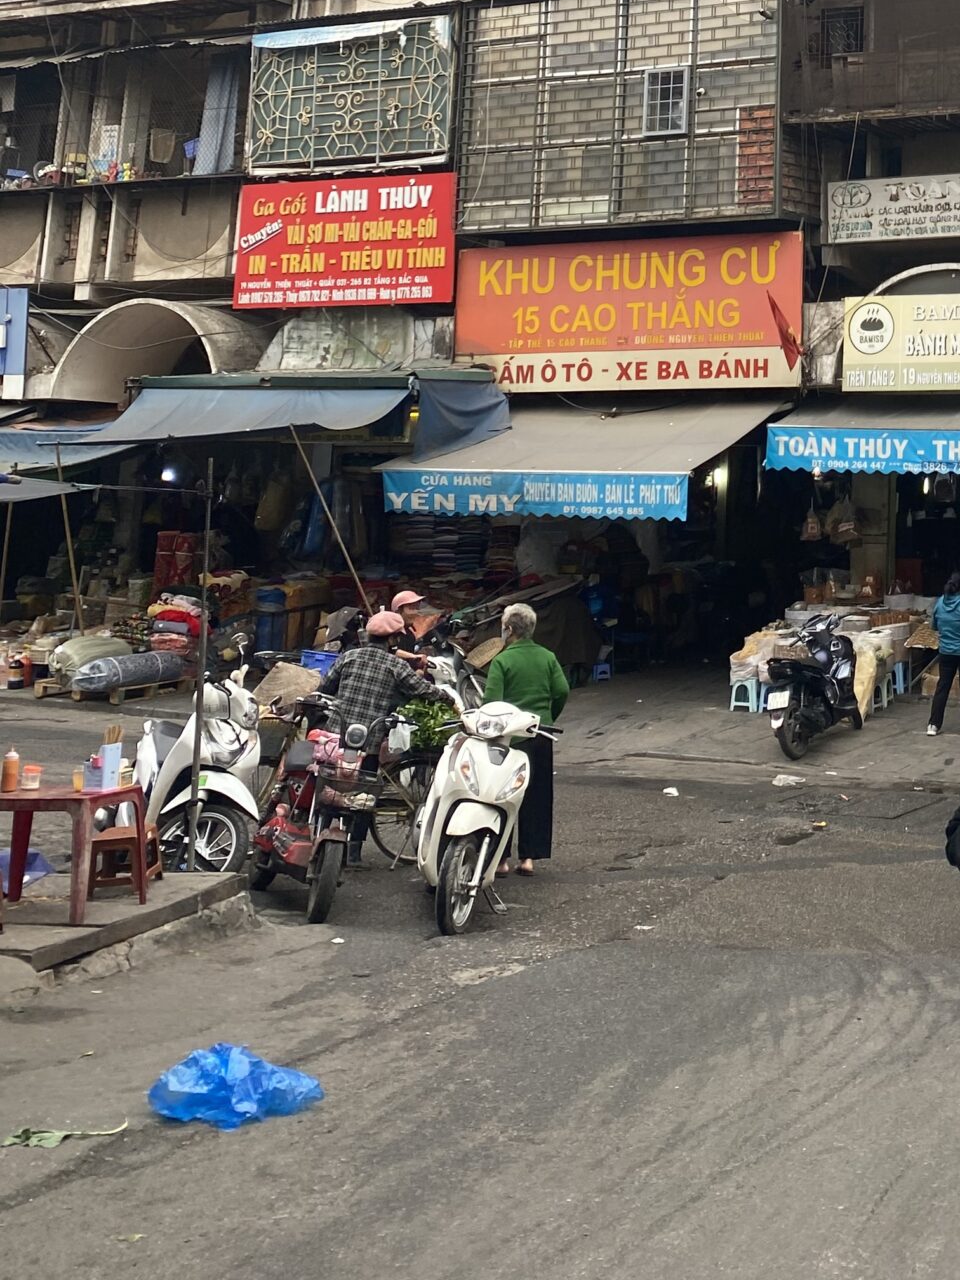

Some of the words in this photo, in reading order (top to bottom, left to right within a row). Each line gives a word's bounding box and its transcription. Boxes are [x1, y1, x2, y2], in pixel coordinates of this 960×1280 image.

[253, 198, 275, 216] Ga
[279, 192, 308, 215] Gối
[315, 184, 368, 213] LÀNH
[378, 178, 433, 210] THỦY
[240, 219, 283, 249] Chuyên:
[287, 218, 305, 245] VẢI
[248, 254, 267, 276] IN
[340, 245, 383, 271] THÊU
[386, 249, 403, 269] VI
[406, 241, 446, 269] TÍNH
[479, 256, 556, 297] KHU
[568, 248, 706, 293] CHUNG
[720, 240, 781, 286] CƯ
[512, 305, 541, 335] 15
[550, 302, 617, 333] CAO
[626, 287, 741, 331] THẮNG
[859, 334, 885, 344] BAMISO
[905, 328, 948, 357] BÁNH
[491, 355, 535, 384] ẤM
[616, 361, 648, 381] XE
[657, 360, 690, 380] BA
[698, 351, 769, 379] BÁNH
[889, 369, 896, 387] 2
[902, 367, 917, 385] 19
[775, 431, 837, 457] TOÀN
[844, 432, 909, 459] THÚY
[851, 460, 868, 470] 264
[870, 461, 886, 470] 447
[420, 473, 449, 487] CỬA
[523, 477, 556, 502] CHUYÊN
[557, 478, 575, 503] BÁN
[575, 479, 599, 504] BUÔN
[605, 479, 622, 504] BÁN
[623, 476, 636, 504] LẺ
[639, 479, 661, 508] PHẬT
[386, 486, 456, 511] YẾN
[468, 493, 522, 512] MY
[580, 505, 602, 515] 0987
[605, 506, 624, 516] 645
